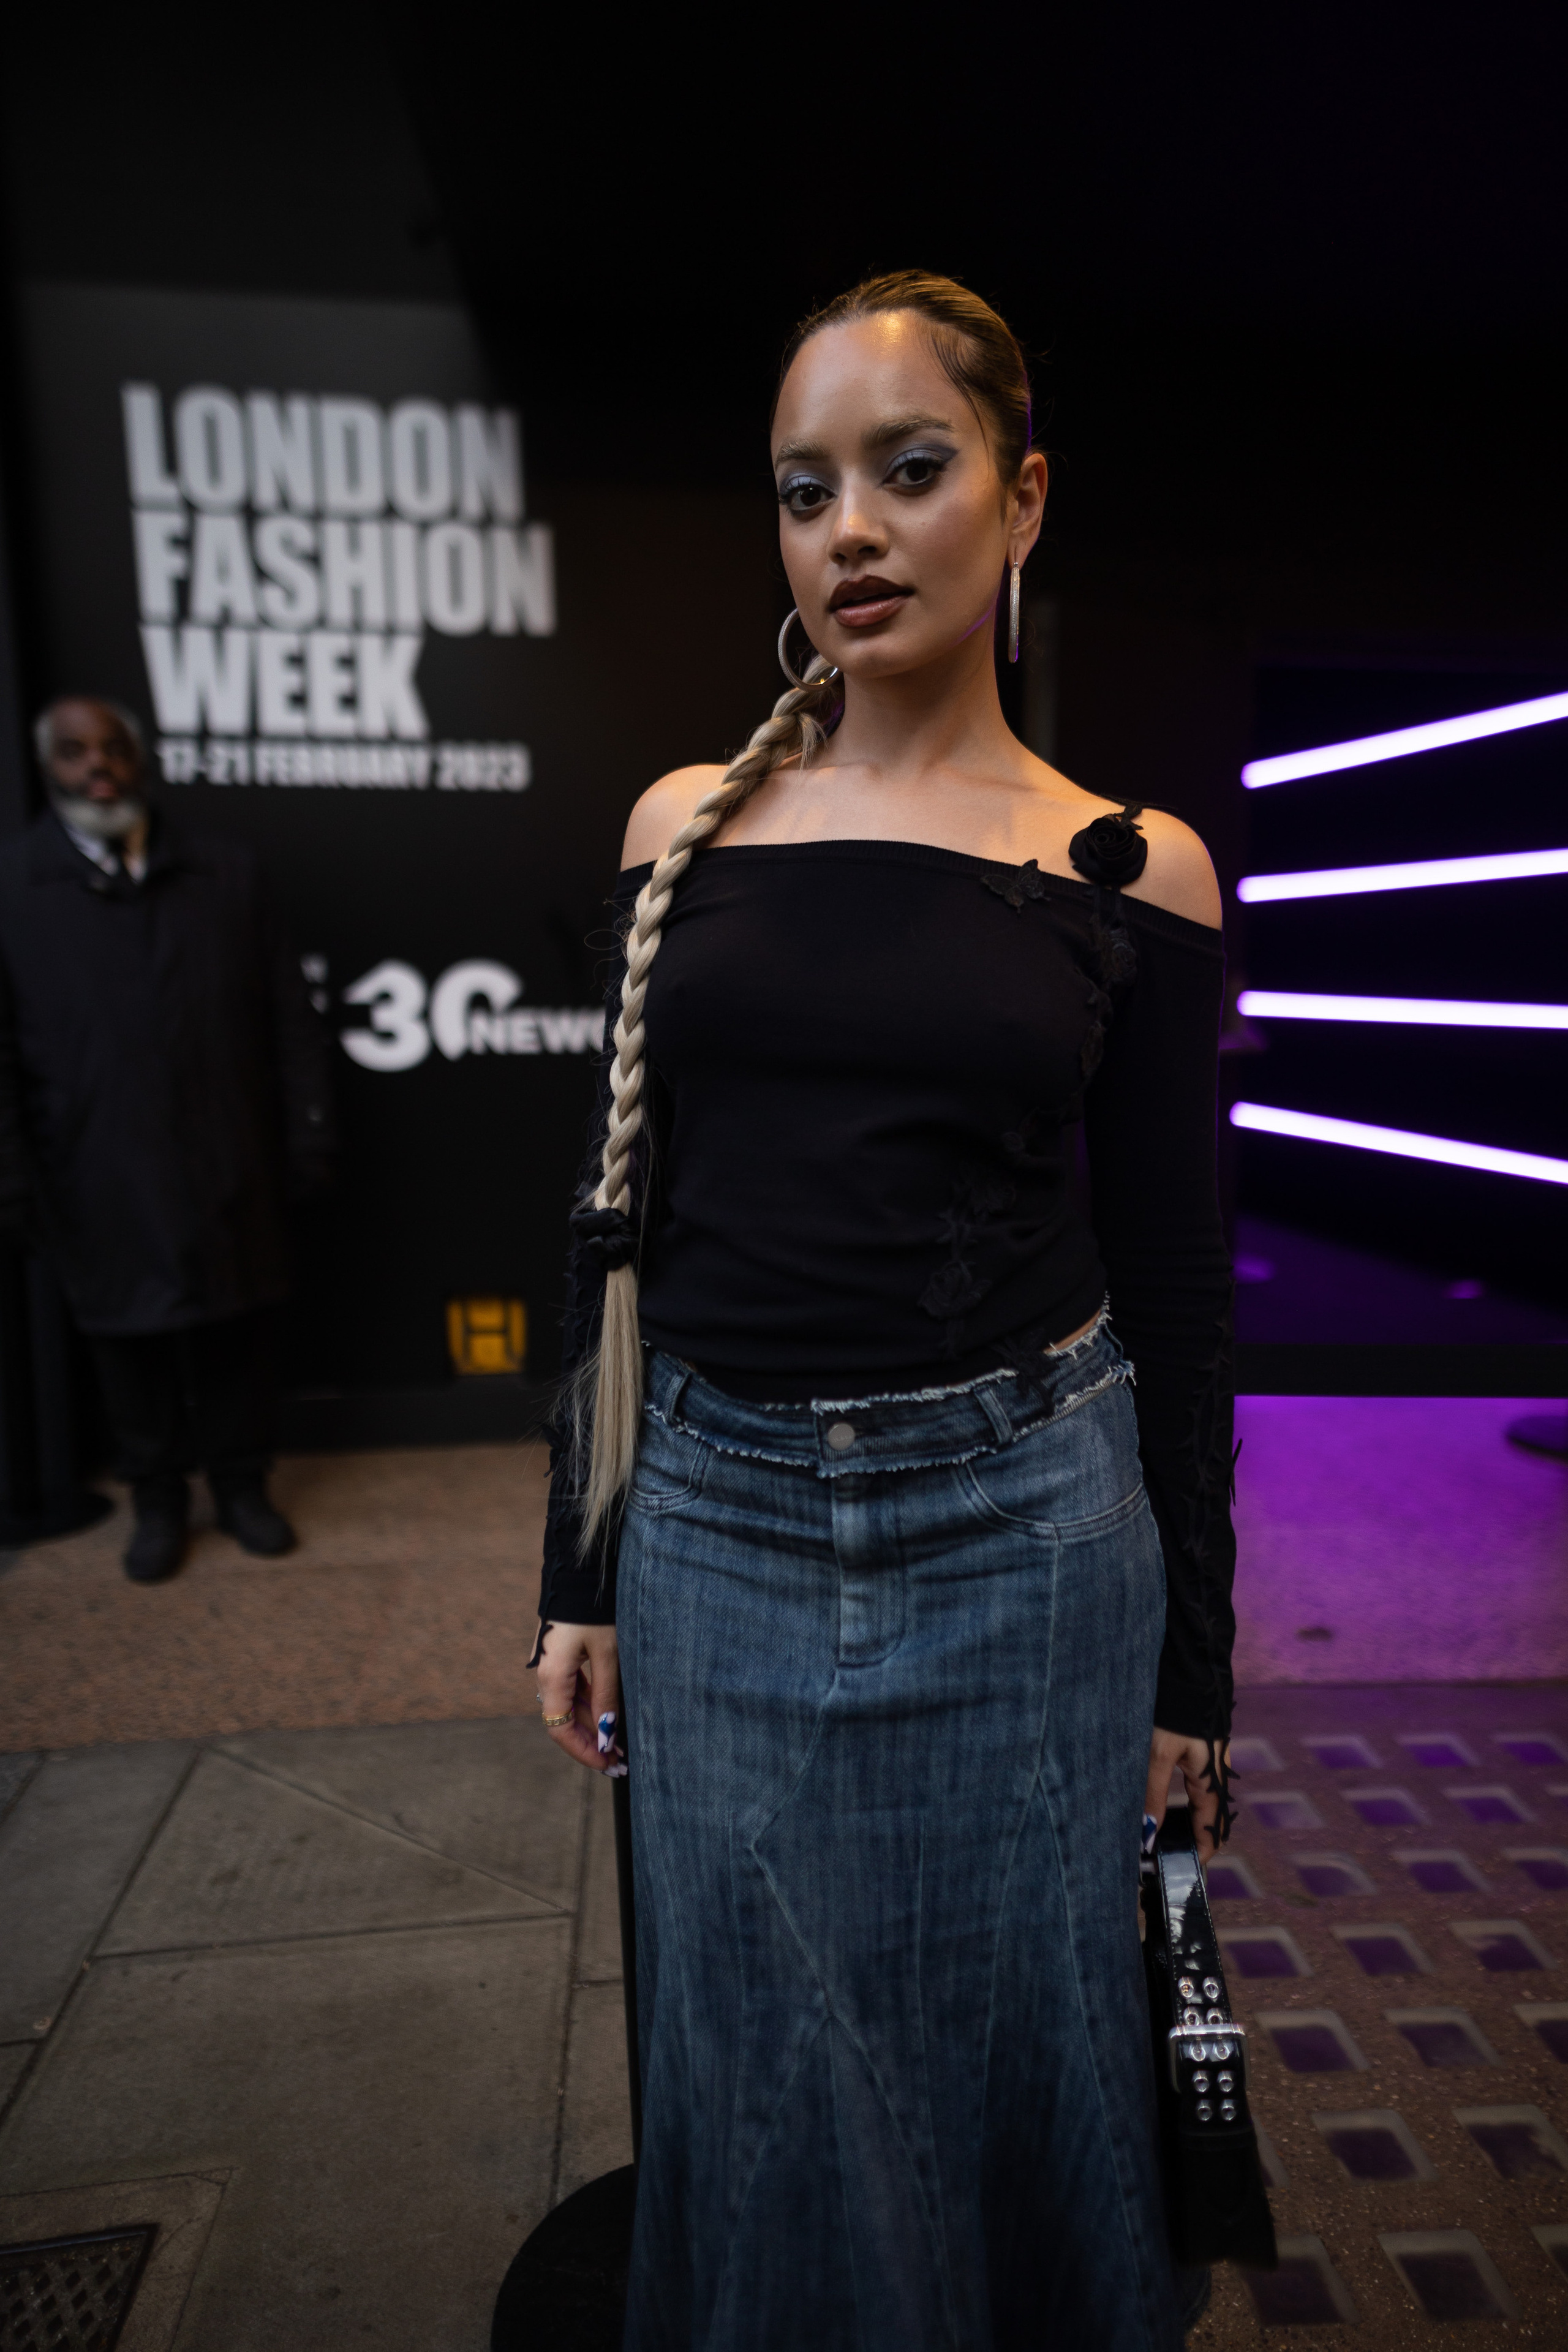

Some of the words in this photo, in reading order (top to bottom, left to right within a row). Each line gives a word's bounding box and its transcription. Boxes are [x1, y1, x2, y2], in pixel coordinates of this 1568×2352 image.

[121, 383, 525, 521] LONDON
[130, 510, 556, 637] FASHION
[138, 625, 430, 740] WEEK
[156, 737, 251, 786] 17-21
[254, 738, 428, 791] FEBRUARY
[433, 741, 532, 793] 2023
